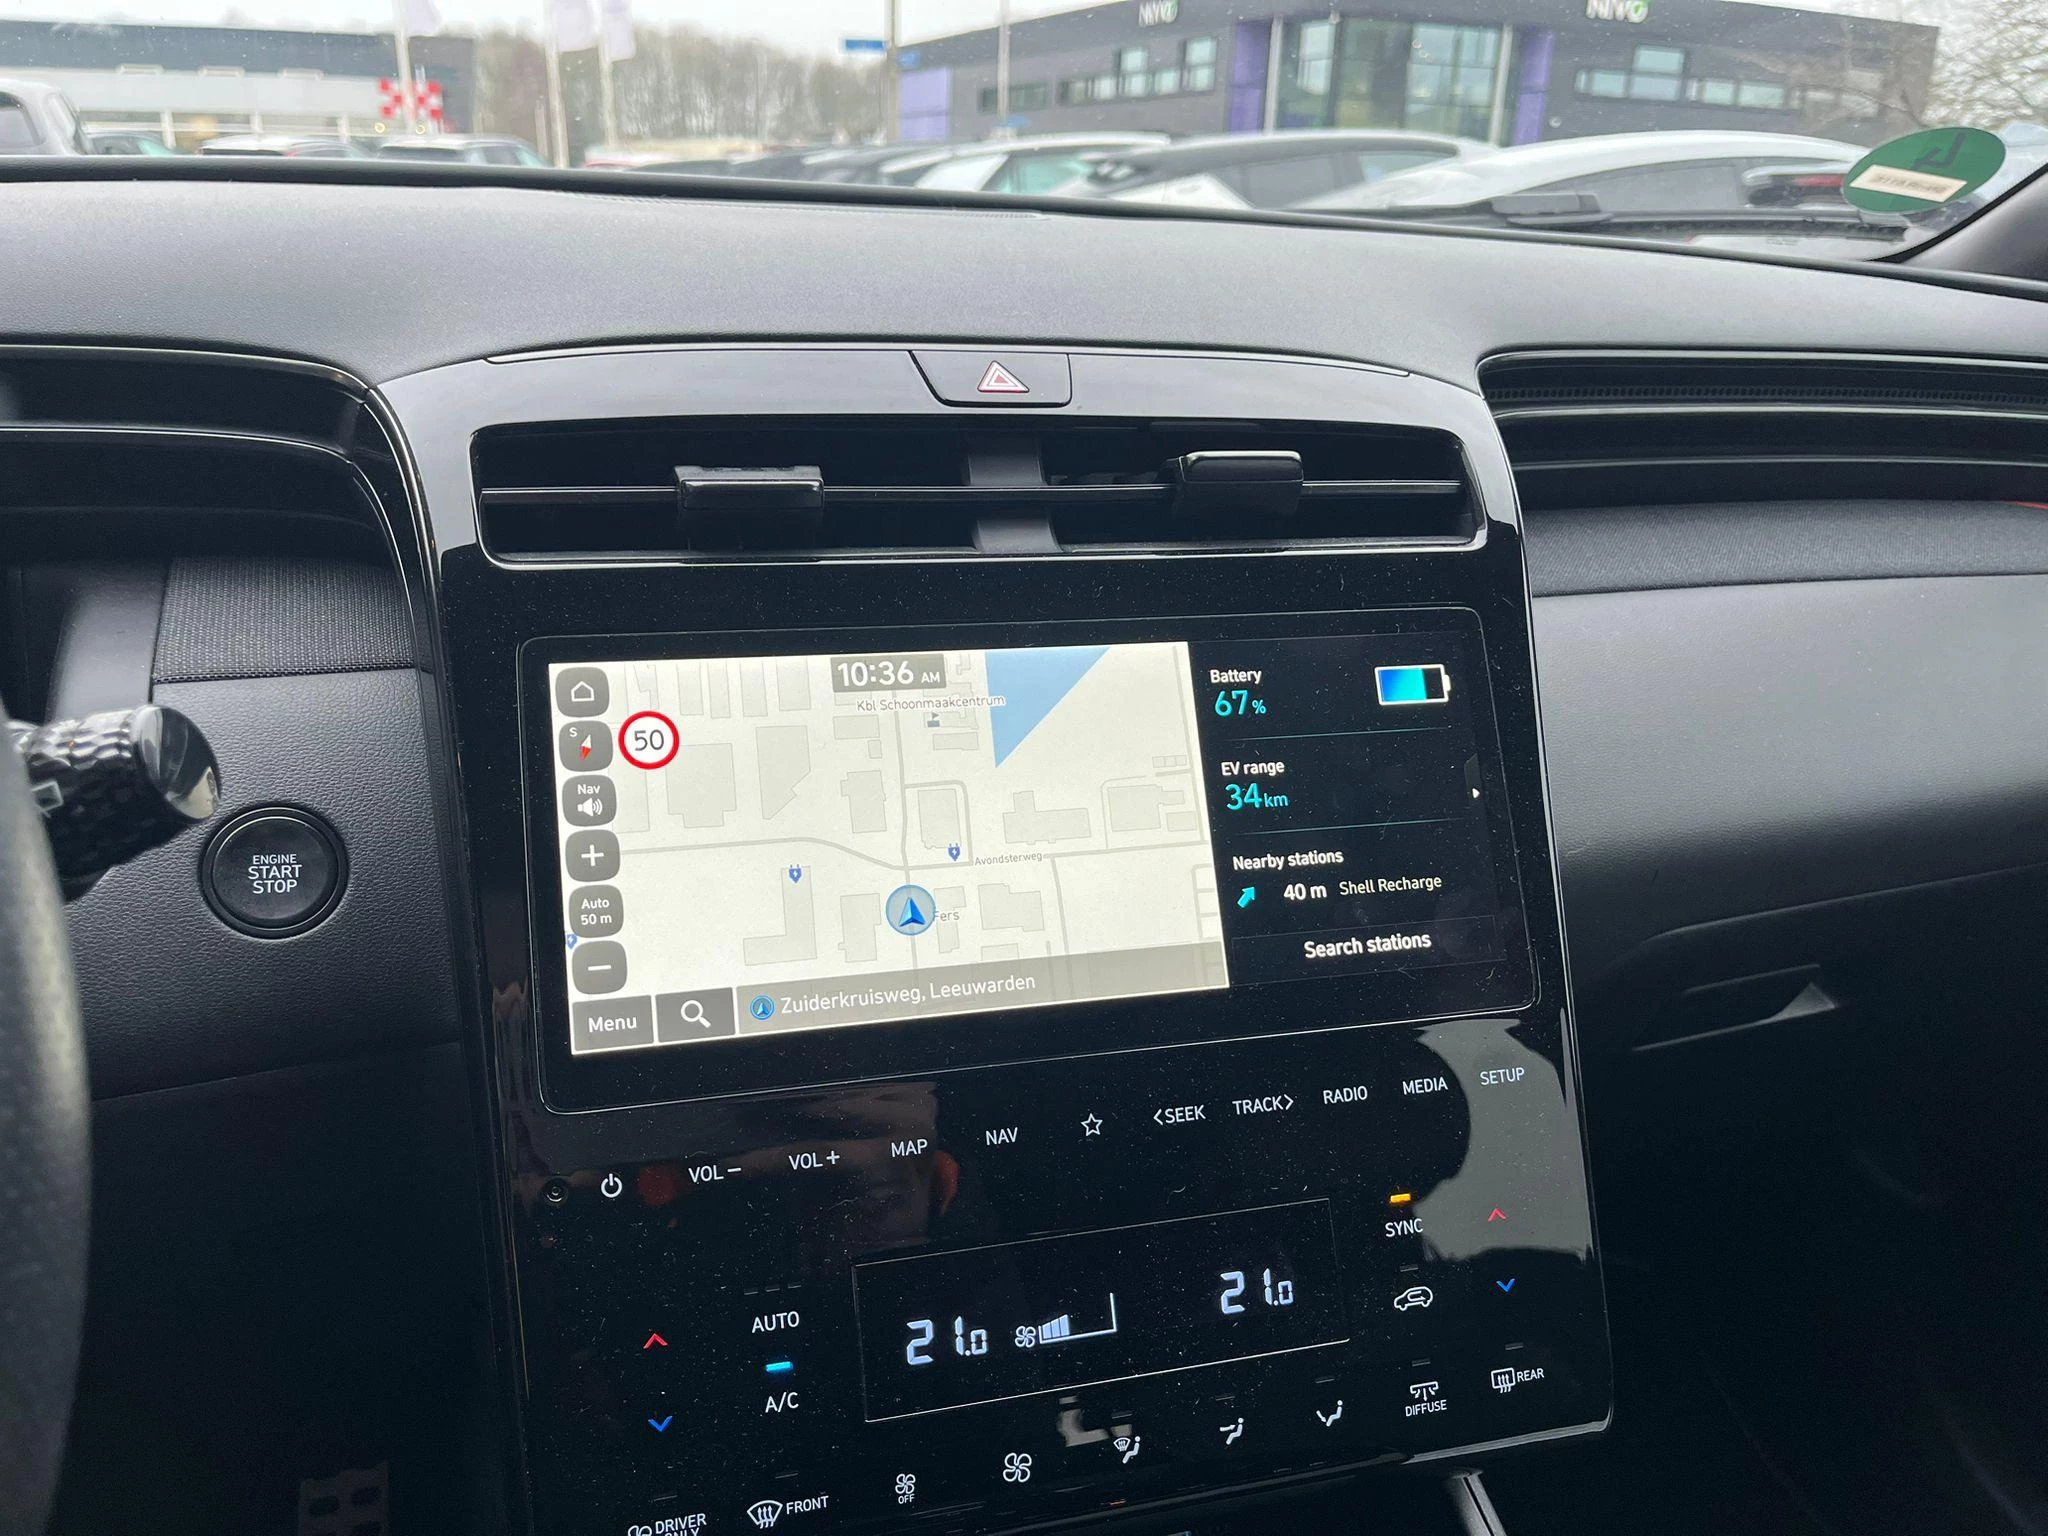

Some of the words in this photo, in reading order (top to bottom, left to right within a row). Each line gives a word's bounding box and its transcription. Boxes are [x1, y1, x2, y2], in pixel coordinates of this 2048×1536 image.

[837, 660, 914, 687] 10:36
[921, 672, 941, 684] AM
[1209, 669, 1262, 684] Battery
[880, 695, 1006, 710] Schoonmaakcentrum
[569, 727, 578, 738] S
[633, 729, 665, 751] 50
[1221, 761, 1241, 776] EV
[1244, 761, 1285, 777] range
[577, 784, 601, 794] Nav
[252, 854, 297, 865] ENGINE
[974, 852, 1043, 866] Avondsterweg
[1233, 855, 1284, 870] Nearby
[1287, 850, 1344, 867] stations
[248, 865, 302, 880] START
[253, 880, 298, 894] STOP
[1283, 884, 1306, 900] 40
[1310, 884, 1327, 898] m
[1339, 881, 1375, 896] Shell
[1378, 875, 1442, 892] Recharge
[581, 898, 610, 909] Auto
[580, 914, 597, 925] 50
[600, 914, 612, 924] m
[1304, 937, 1363, 959] Search
[1366, 933, 1432, 953] stations
[780, 986, 926, 1014] Zuiderkruisweg,
[930, 975, 1036, 999] Leeuwarden
[588, 1017, 637, 1033] Menu
[1479, 1066, 1525, 1086] SETUP
[1323, 1085, 1368, 1104] RADIO
[1402, 1076, 1448, 1096] MEDIA
[985, 1127, 1019, 1146] NAV
[890, 1139, 929, 1159] MAP
[1384, 1218, 1424, 1238] SYNC
[751, 1310, 800, 1334] AUTO
[1517, 1367, 1545, 1382] REAR
[765, 1391, 799, 1413] A/C
[1405, 1400, 1447, 1417] DIFFUSE
[786, 1496, 829, 1515] FRONT
[897, 1492, 915, 1503] OFF
[655, 1512, 707, 1534] DRIVER
